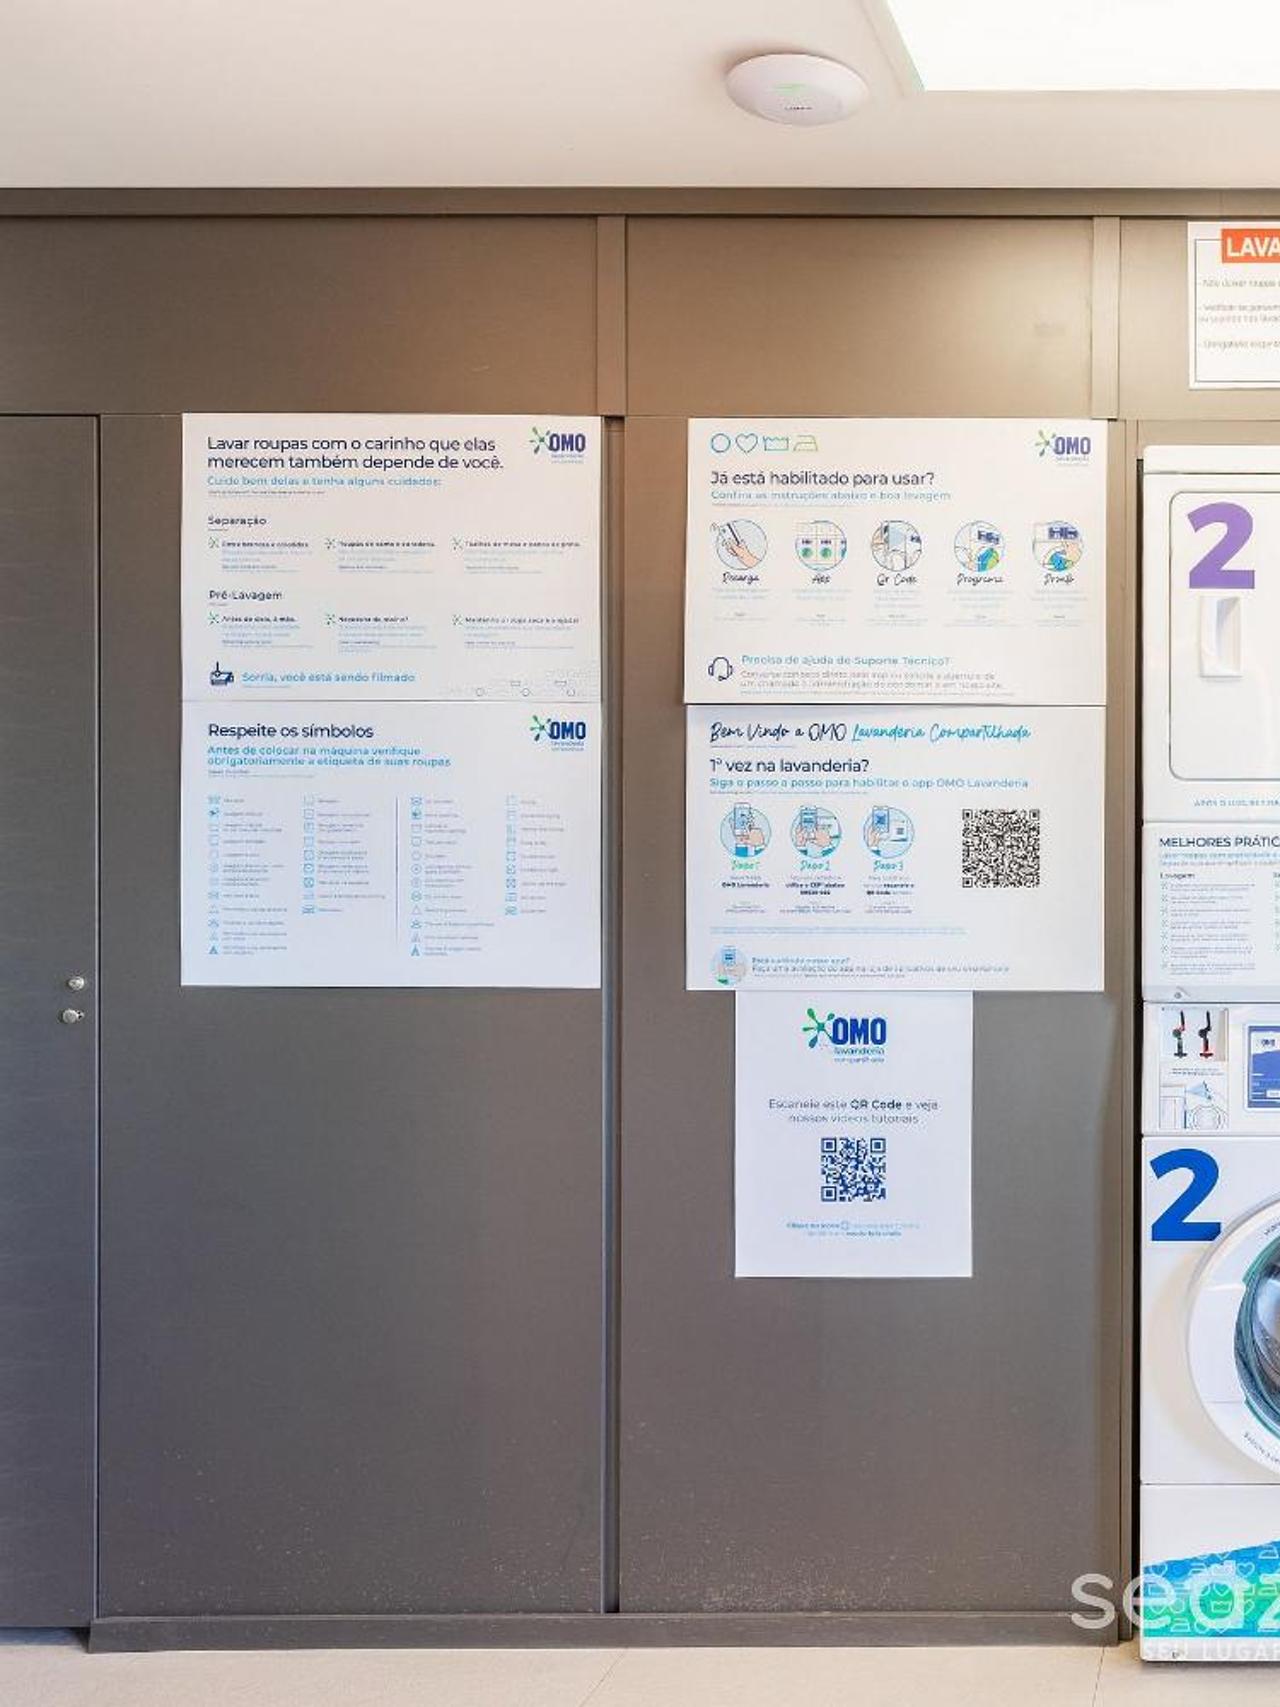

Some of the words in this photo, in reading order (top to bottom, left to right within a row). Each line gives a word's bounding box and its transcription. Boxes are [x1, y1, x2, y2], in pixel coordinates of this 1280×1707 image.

[208, 436, 249, 450] Lavar
[253, 438, 308, 452] roupas
[312, 439, 347, 450] com
[351, 439, 361, 450] o
[365, 437, 425, 450] carinho
[430, 439, 459, 453] que
[464, 437, 495, 450] elas
[549, 433, 585, 452] OMO
[1054, 437, 1091, 454] OMO
[208, 456, 284, 468] merecem
[289, 454, 357, 468] também
[363, 455, 434, 471] depende
[438, 456, 458, 468] de
[462, 456, 504, 468] você.
[711, 470, 728, 484] Já
[732, 470, 766, 484] está
[769, 470, 849, 484] habilitado
[853, 474, 888, 487] para
[892, 472, 934, 485] usar?
[208, 516, 267, 528] Separação
[1186, 502, 1255, 589] 2
[242, 672, 277, 684] Sorria,
[280, 672, 307, 682] você
[309, 672, 334, 682] está
[336, 672, 369, 682] sendo
[372, 672, 416, 682] filmado
[208, 723, 276, 740] Respeite
[280, 726, 299, 738] os
[302, 724, 374, 738] símbolos
[550, 722, 586, 740] OMO
[710, 721, 744, 743] Bem
[747, 723, 790, 741] Vindo
[795, 728, 804, 737] a
[808, 722, 847, 741] OMO
[852, 723, 925, 742] Lavanderia
[930, 723, 1031, 742] Compartilhada
[208, 746, 240, 756] Antes
[242, 746, 256, 756] de
[259, 746, 299, 756] colocar
[303, 748, 316, 756] na
[320, 746, 370, 758] máquina
[317, 757, 364, 768] etiqueta
[367, 757, 380, 766] de
[412, 758, 451, 768] roupas
[724, 762, 752, 772] vez
[756, 762, 776, 772] na
[780, 759, 870, 772] lavanderia?
[710, 778, 734, 789] Siga
[746, 780, 779, 789] passo
[790, 780, 822, 789] passo
[936, 778, 965, 788] OMO
[1159, 837, 1232, 848] MELHORES
[832, 1017, 886, 1045] OMO
[834, 1046, 884, 1055] lavanderia
[850, 1100, 868, 1110] QR
[872, 1099, 902, 1109] Code
[916, 1100, 938, 1112] veja
[1150, 1148, 1222, 1242] 2
